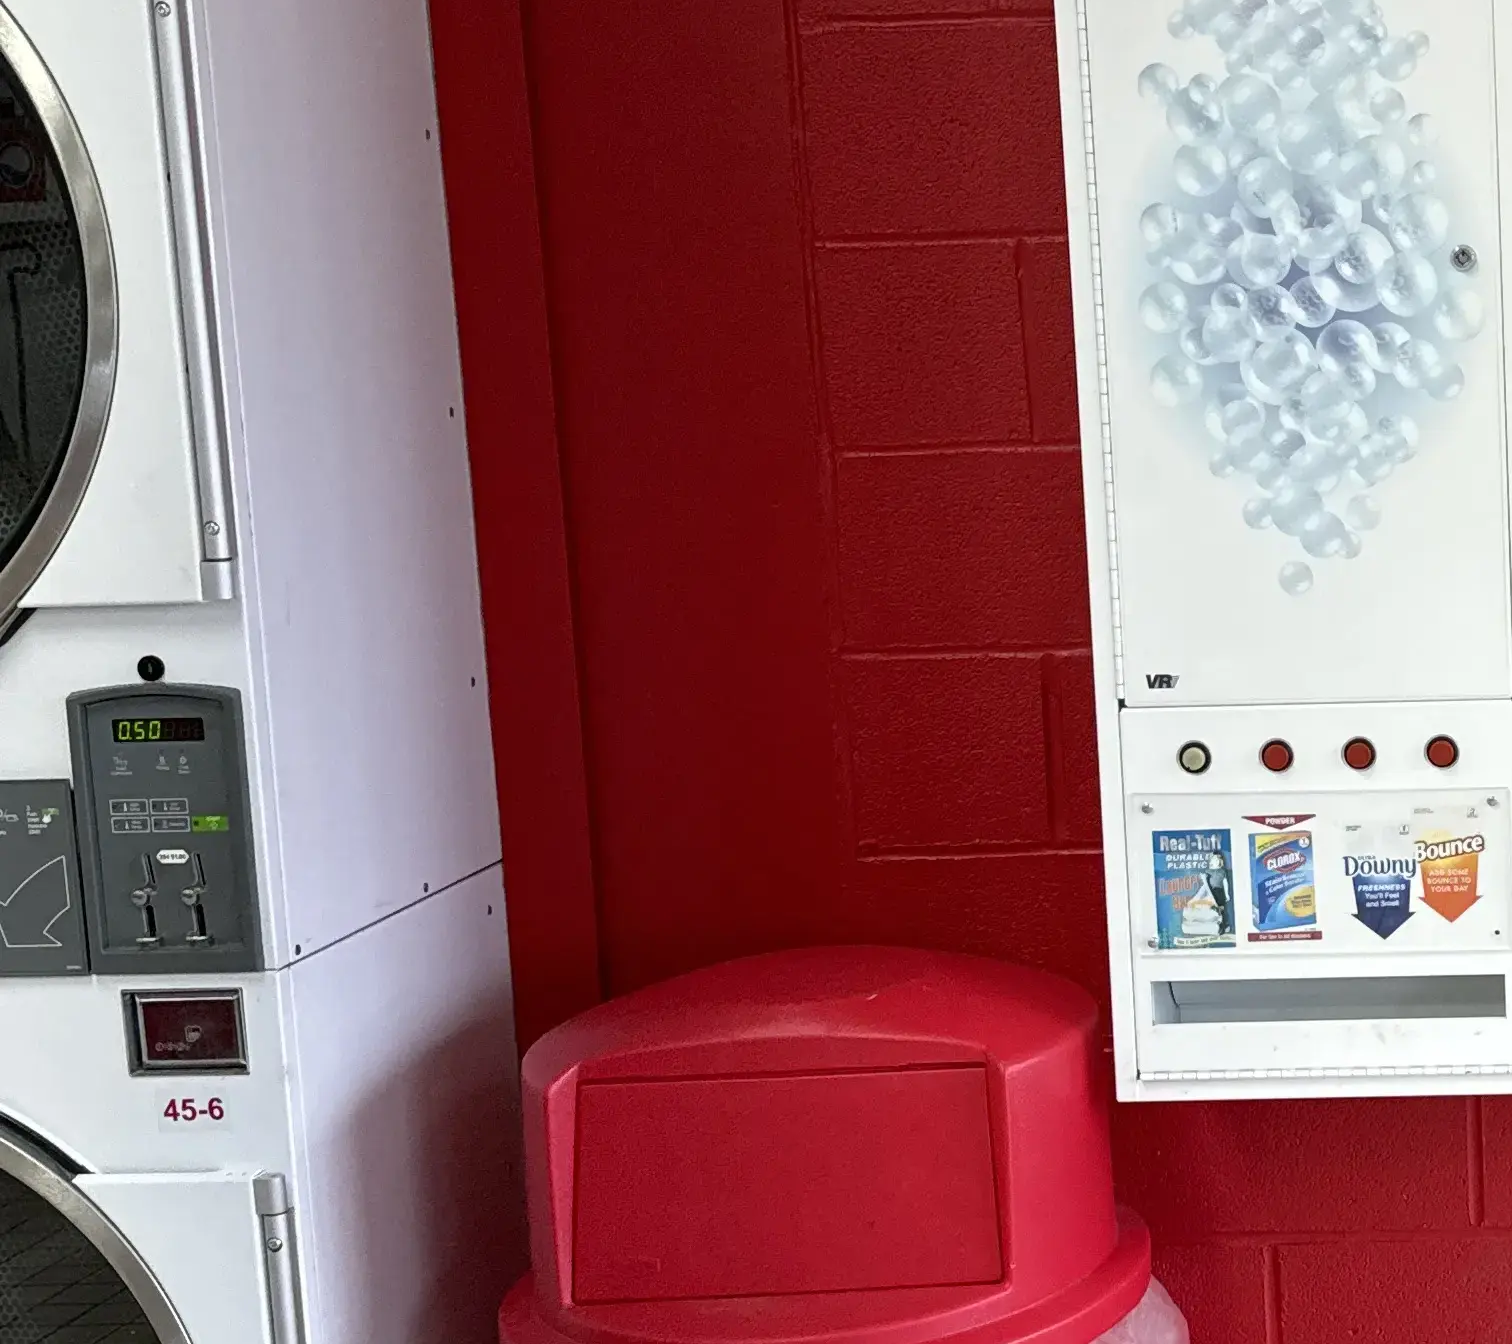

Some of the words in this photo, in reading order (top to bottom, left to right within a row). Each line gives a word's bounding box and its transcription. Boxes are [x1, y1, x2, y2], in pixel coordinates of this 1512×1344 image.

[1265, 817, 1296, 825] POWDER
[1159, 833, 1222, 852] Real-Tuff
[1414, 834, 1485, 864] Bounce
[1167, 861, 1208, 869] PLASTIC
[1266, 852, 1301, 871] CLOROX
[1343, 855, 1417, 878] Downy
[1427, 877, 1459, 885] BOUNCE
[163, 1097, 224, 1121] 45-6
